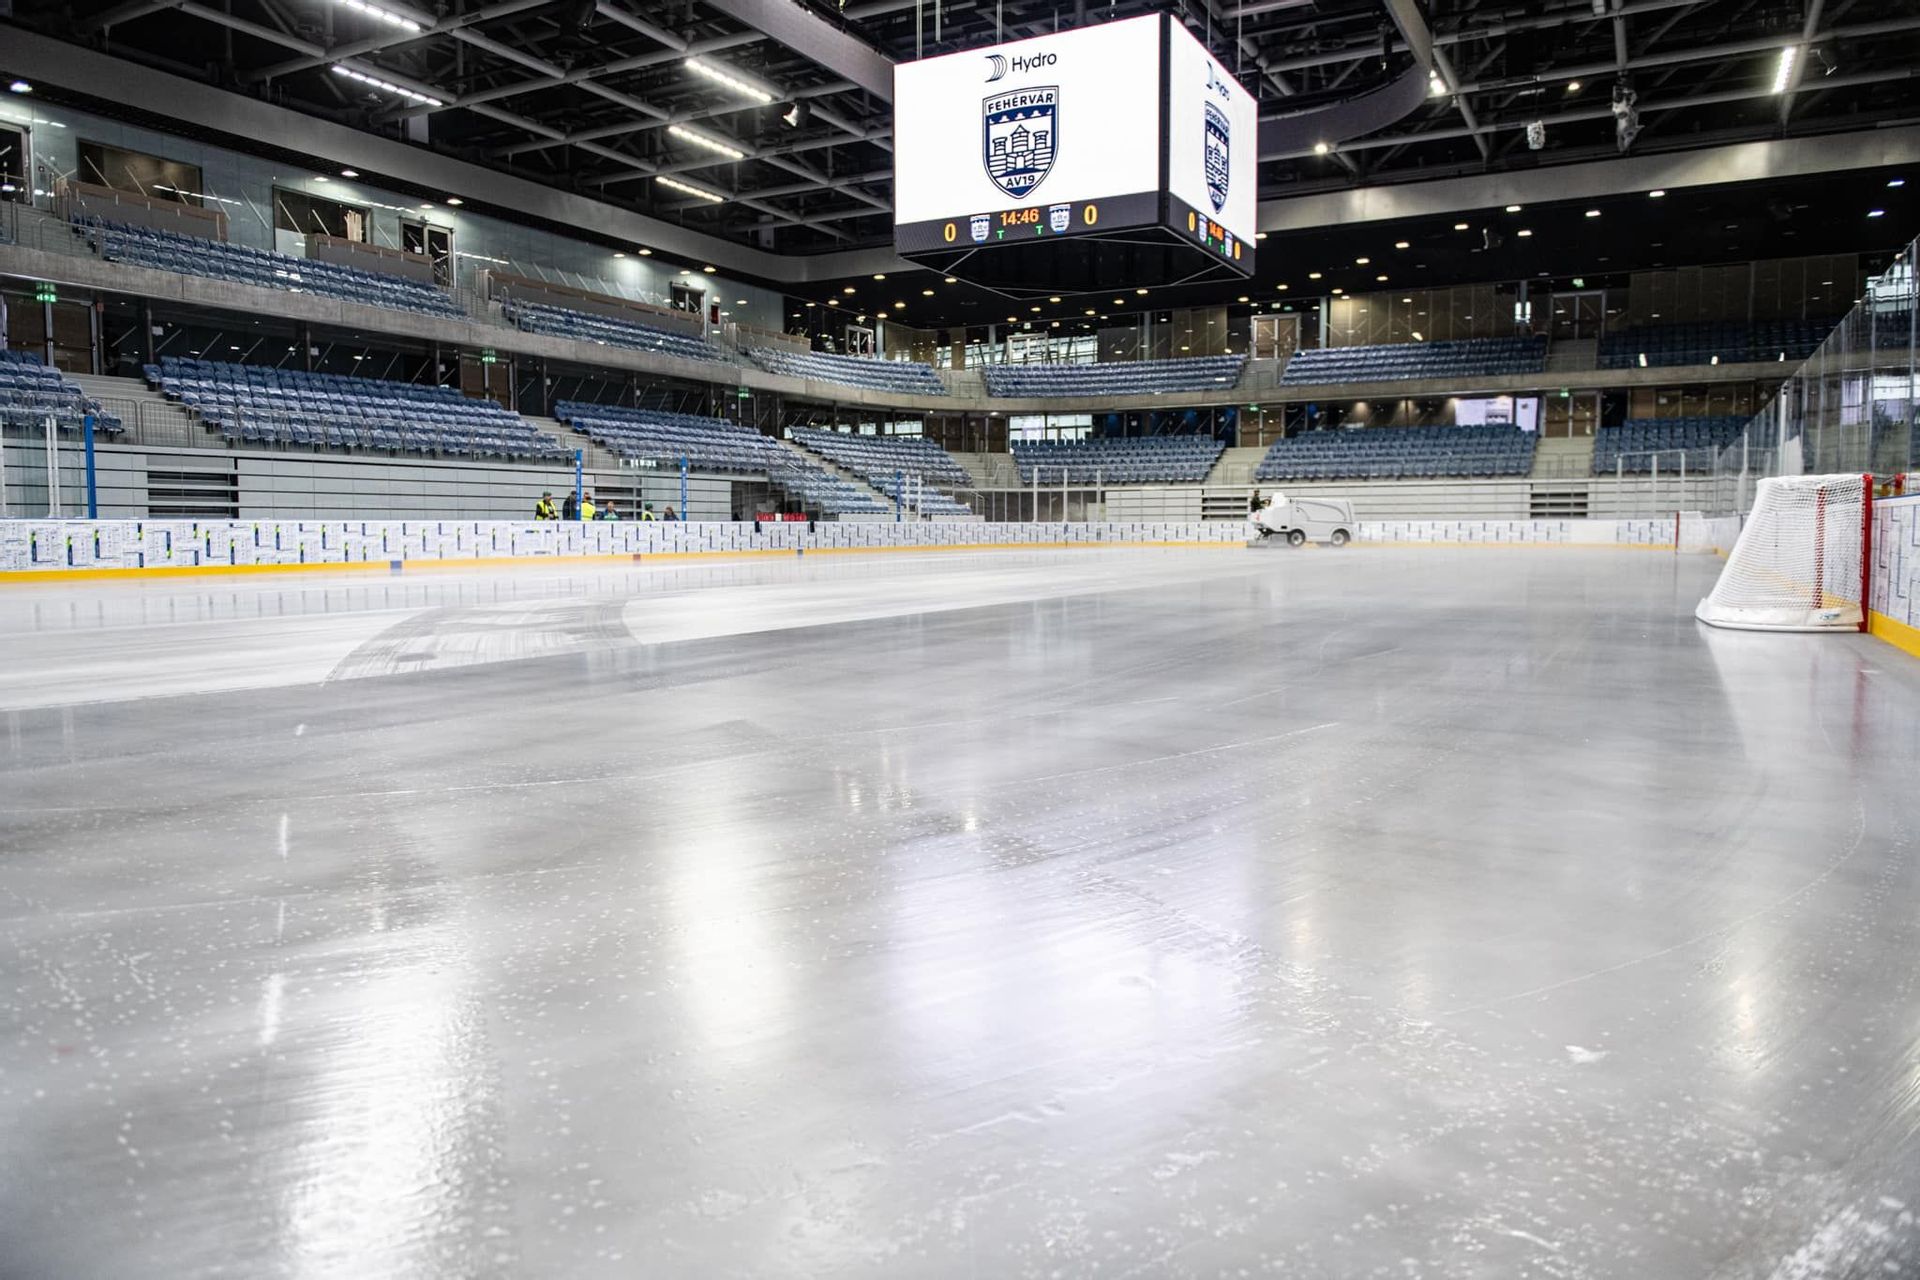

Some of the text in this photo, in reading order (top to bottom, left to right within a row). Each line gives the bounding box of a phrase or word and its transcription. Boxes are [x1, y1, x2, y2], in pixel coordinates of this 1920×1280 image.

[1011, 52, 1057, 73] Hydro
[987, 91, 1054, 113] FEHÉRVÁR
[1005, 174, 1036, 188] AV19
[1000, 207, 1040, 227] 14:46
[1084, 203, 1098, 226] 0
[944, 222, 957, 243] 0
